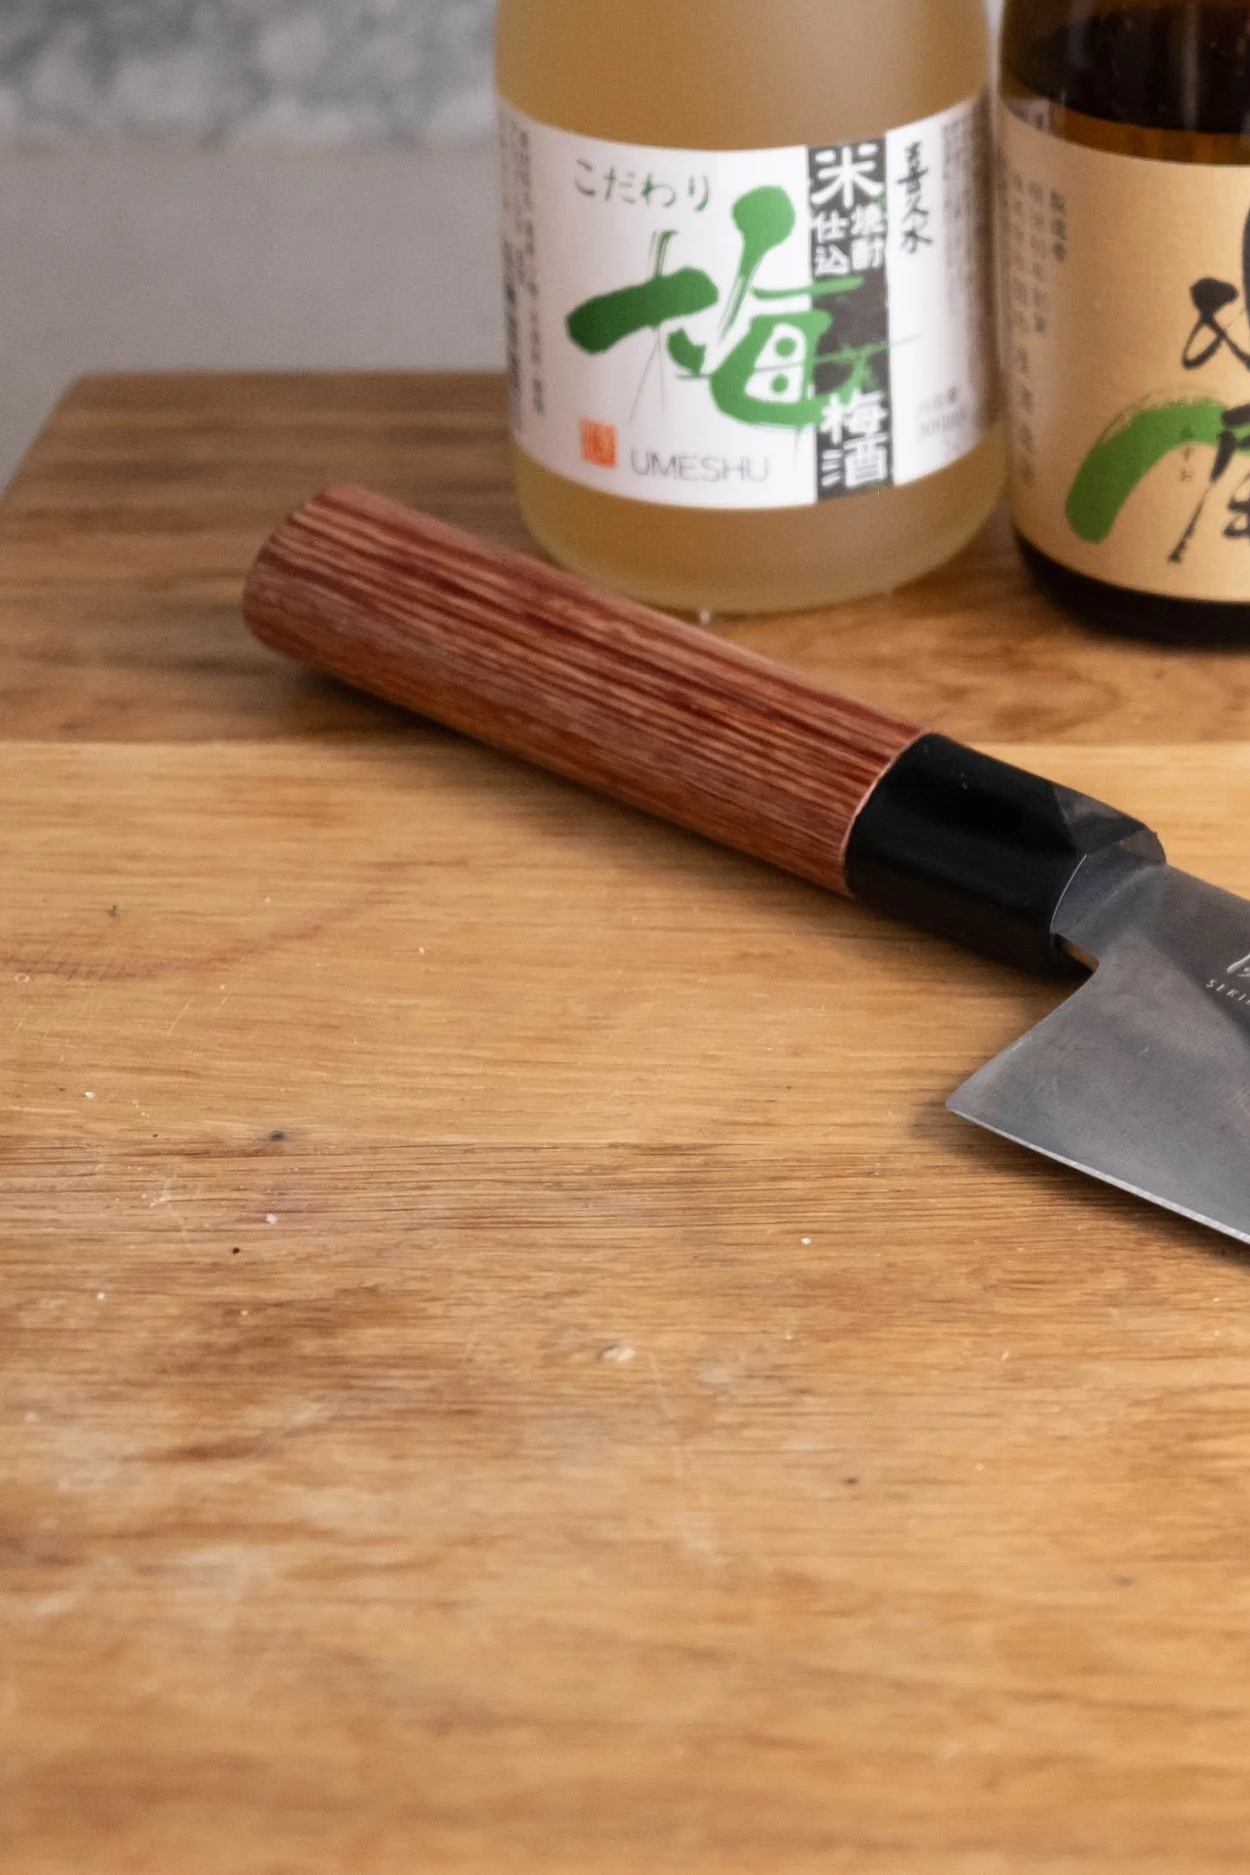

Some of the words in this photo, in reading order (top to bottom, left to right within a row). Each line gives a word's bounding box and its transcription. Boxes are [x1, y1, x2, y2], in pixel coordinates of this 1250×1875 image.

[574, 159, 712, 212] こだわり
[630, 449, 770, 484] UMESHU
